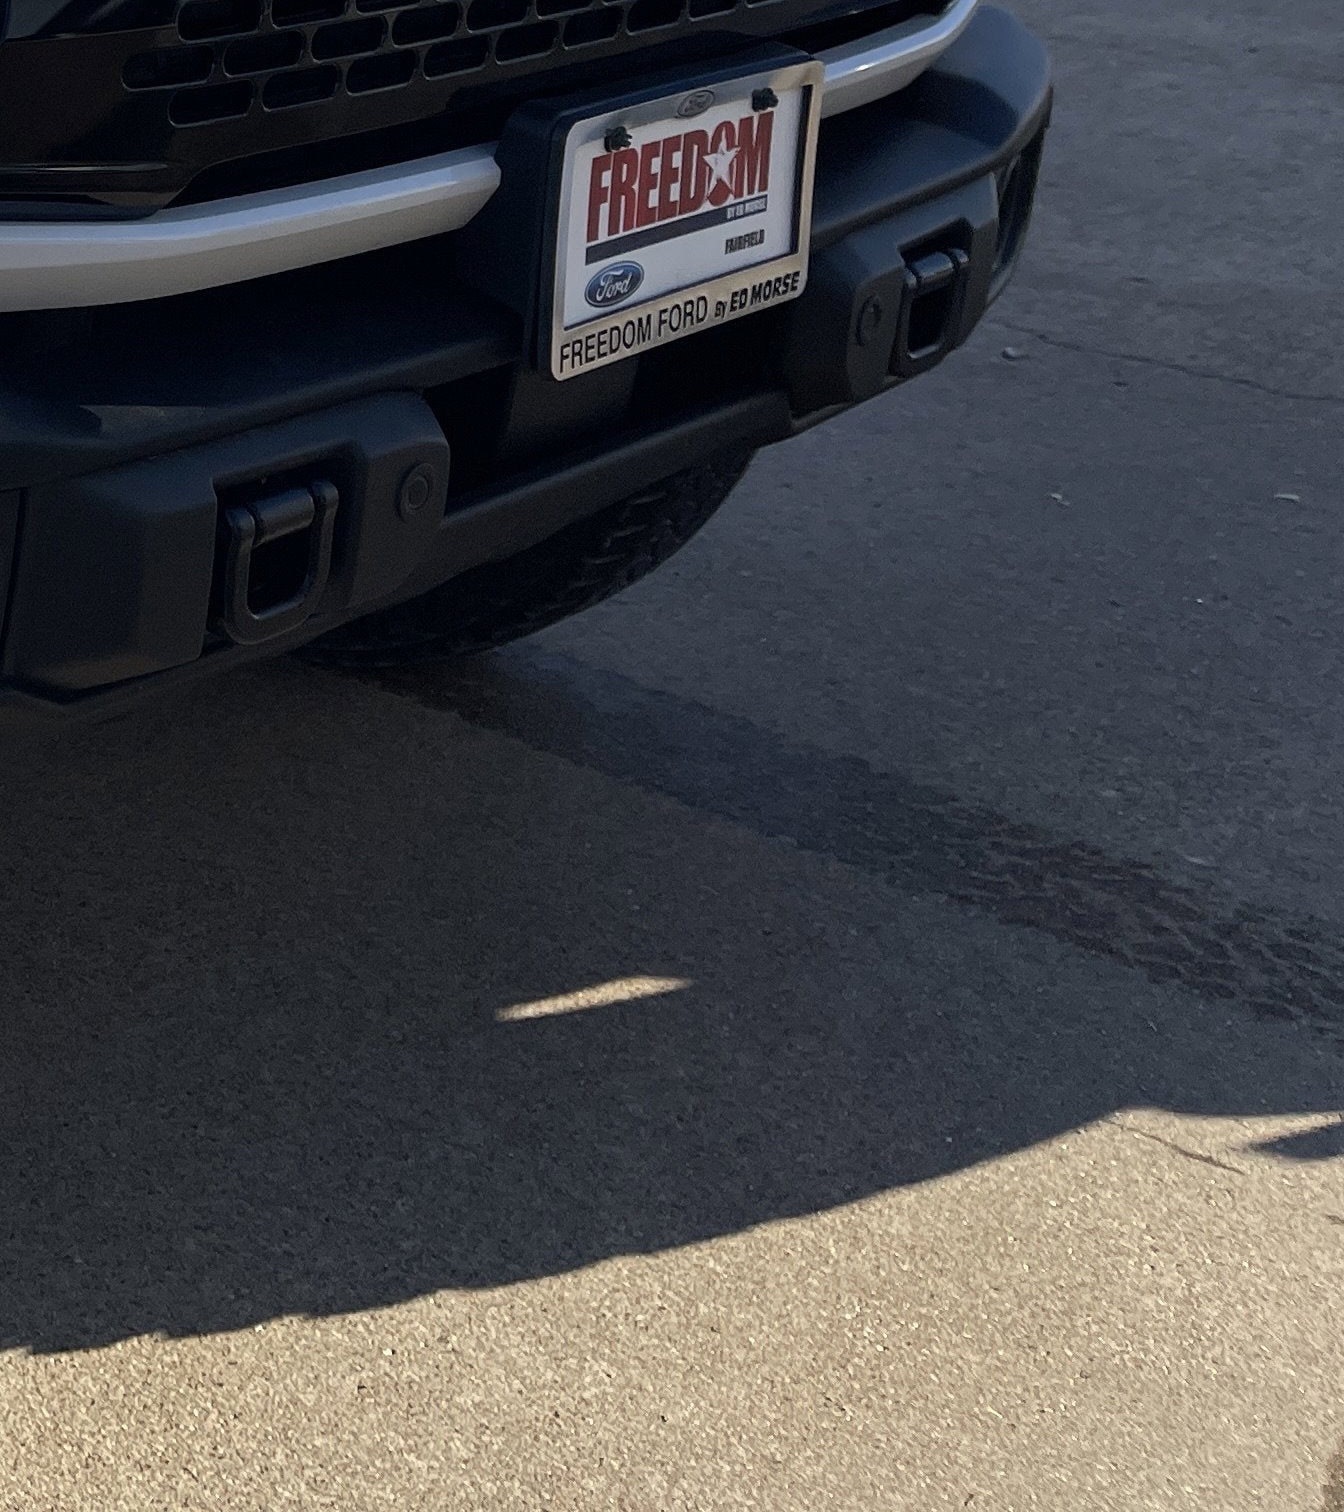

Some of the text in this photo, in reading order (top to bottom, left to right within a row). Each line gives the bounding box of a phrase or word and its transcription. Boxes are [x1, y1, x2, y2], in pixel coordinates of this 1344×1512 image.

[586, 110, 775, 243] FREEDOM
[559, 313, 652, 373] FREEDOM
[657, 295, 708, 337] FORD
[729, 287, 748, 313] ED
[750, 270, 801, 306] MORSE
[595, 269, 632, 301] Ford
